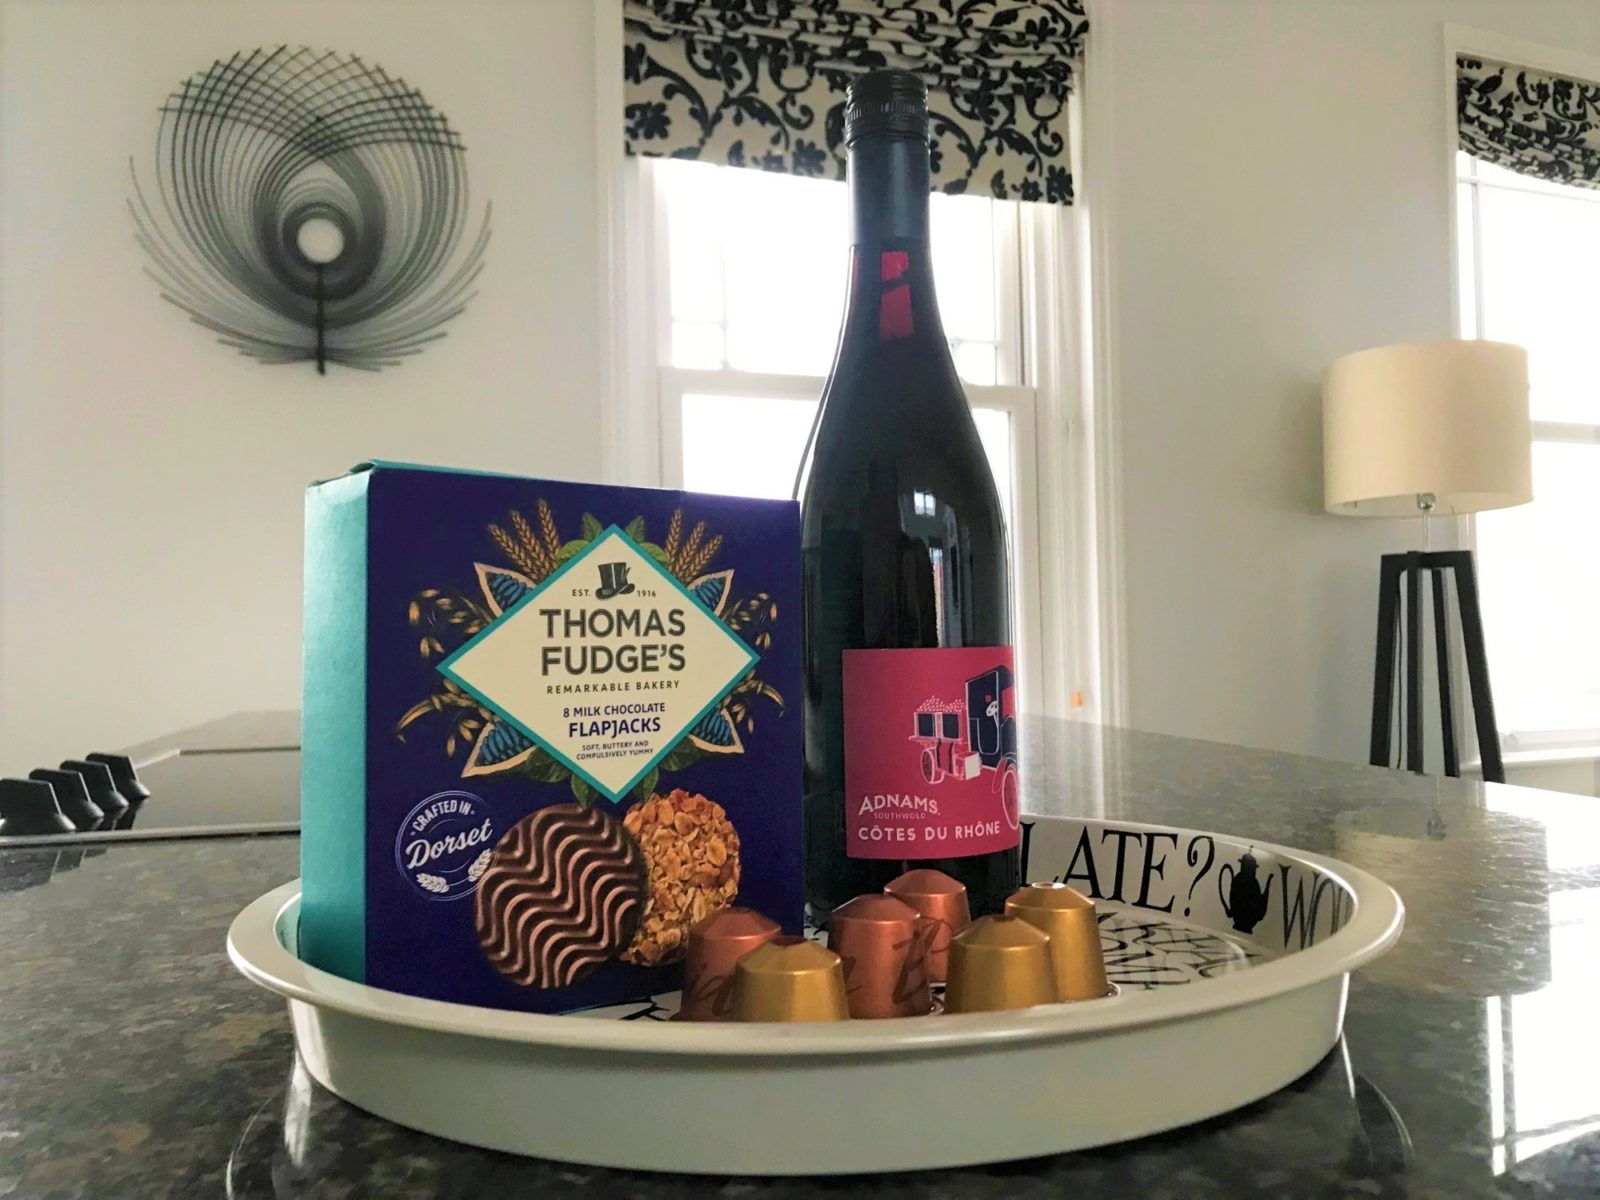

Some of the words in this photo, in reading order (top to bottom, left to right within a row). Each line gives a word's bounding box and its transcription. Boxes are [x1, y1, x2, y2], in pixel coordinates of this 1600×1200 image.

[572, 588, 592, 597] EST.
[636, 589, 657, 598] 1916
[539, 608, 686, 639] THOMAS
[541, 643, 686, 676] FUDGE'S
[546, 682, 630, 695] REMARKABLE
[635, 680, 680, 691] BAKERY
[563, 707, 570, 718] 8
[573, 706, 601, 717] MILK
[604, 702, 666, 716] CHOCOLATE
[568, 717, 661, 739] FLAPJACKS
[576, 750, 627, 760] COMPULSIVELY
[602, 742, 632, 750] BUTTERY
[412, 800, 458, 832] CRAFTED
[459, 801, 472, 815] IN
[873, 812, 927, 820] SOUTHWOLD
[858, 825, 916, 841] CÔTES
[924, 826, 948, 840] DU
[954, 820, 1000, 840] RHÔNE
[405, 818, 493, 869] Dorset
